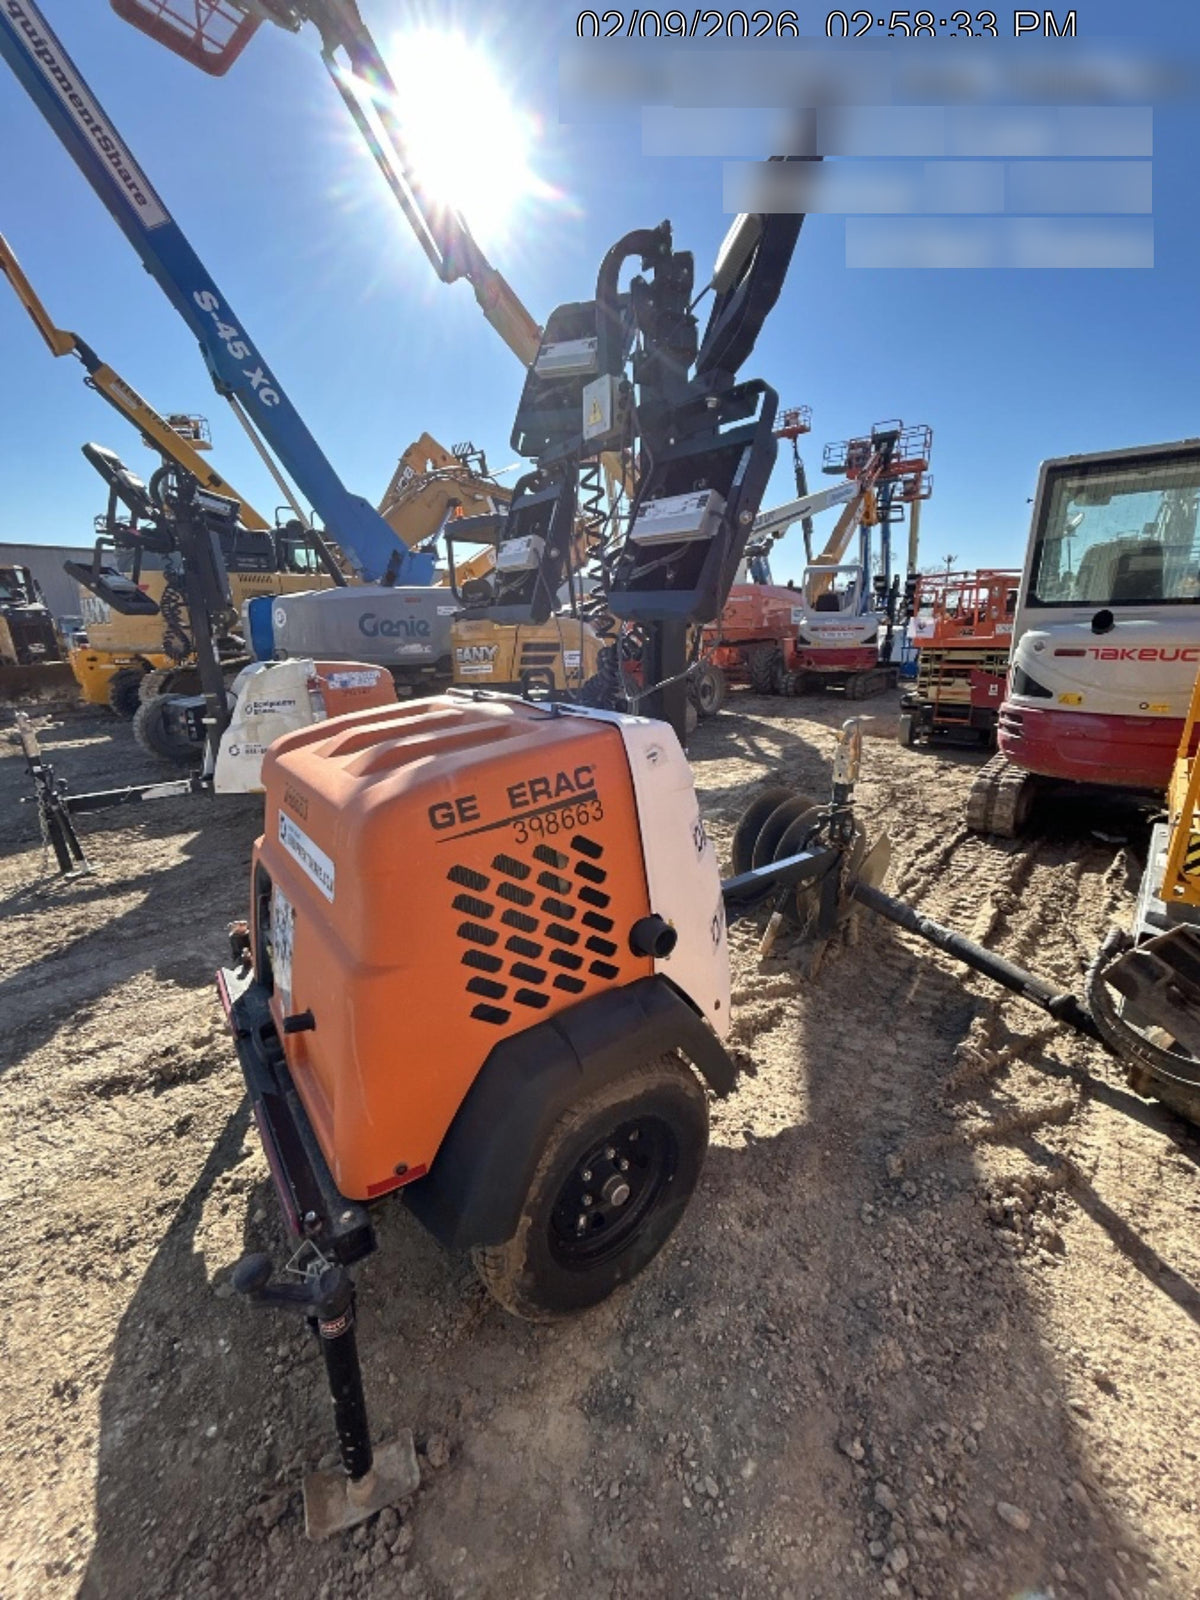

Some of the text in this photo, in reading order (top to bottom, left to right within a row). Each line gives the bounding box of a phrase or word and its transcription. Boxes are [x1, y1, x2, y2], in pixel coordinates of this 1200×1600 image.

[6, 1, 148, 207] quipmentShare
[193, 290, 281, 407] S-45 XC
[358, 612, 431, 638] Genie
[1087, 647, 1200, 662] TAKEUC
[512, 799, 604, 844] 398663
